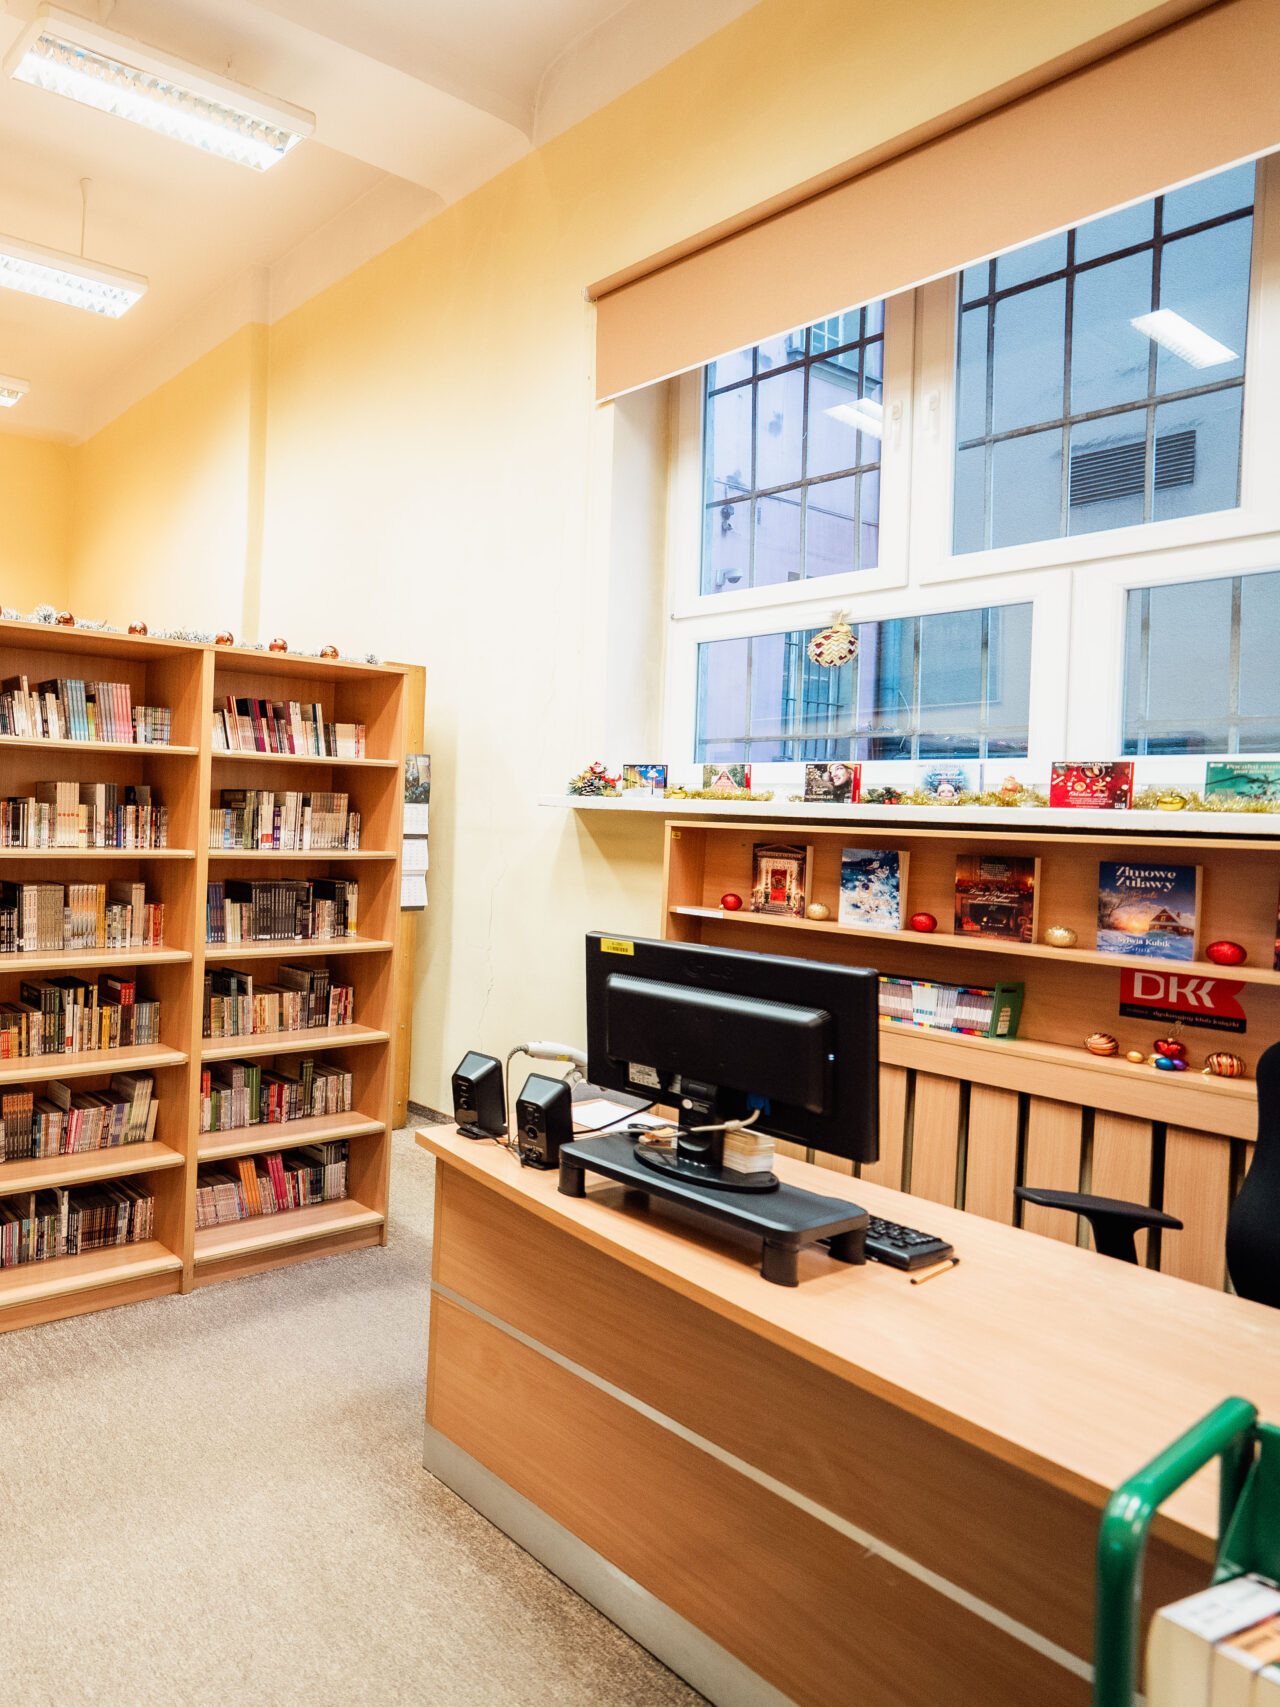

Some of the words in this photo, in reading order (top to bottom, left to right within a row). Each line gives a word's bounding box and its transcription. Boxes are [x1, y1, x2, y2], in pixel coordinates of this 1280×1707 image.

[1116, 866, 1177, 879] Zimowe
[1145, 938, 1171, 948] Kubik
[1133, 971, 1217, 1008] DKK
